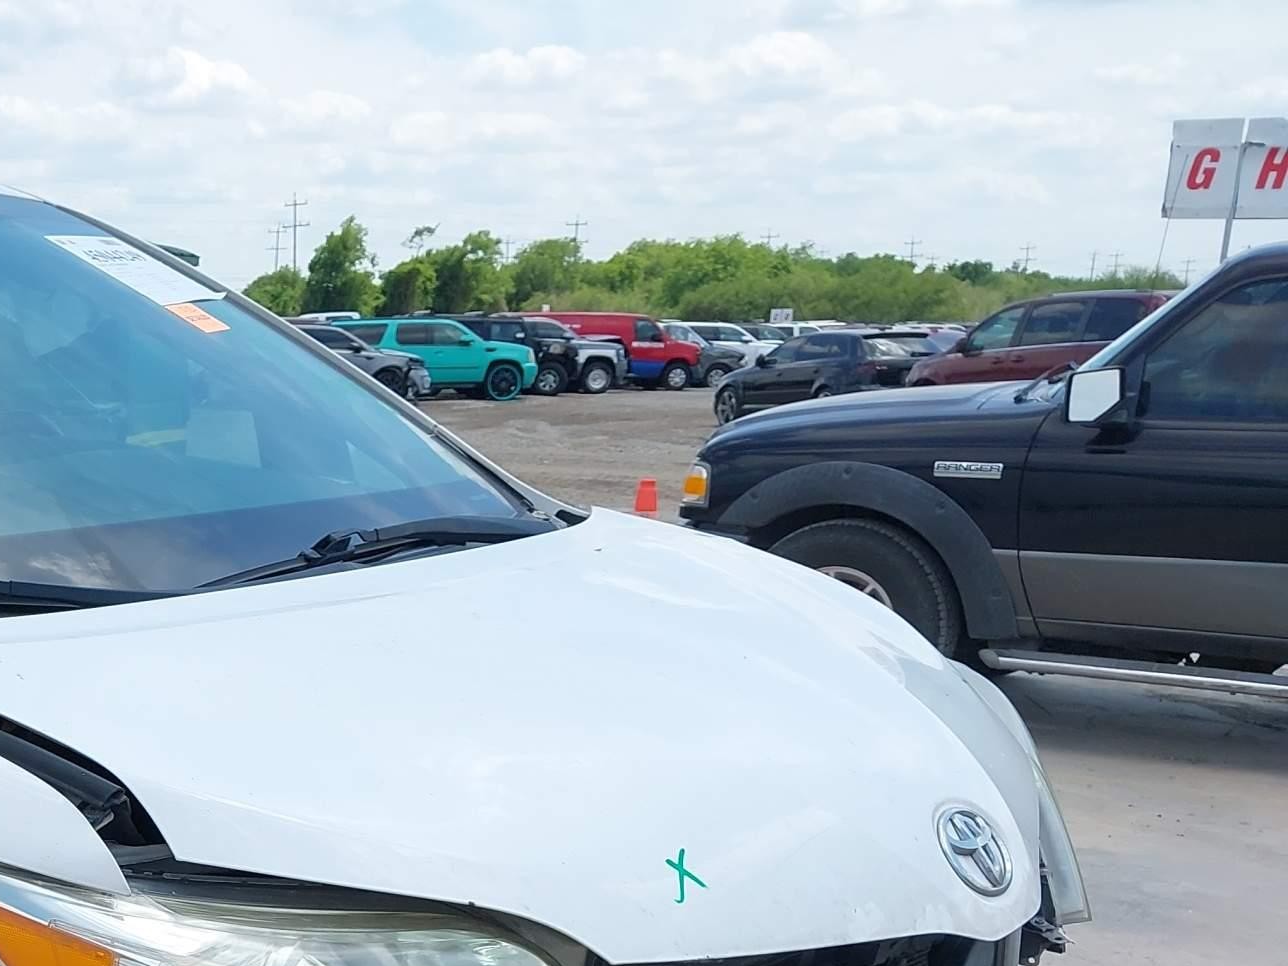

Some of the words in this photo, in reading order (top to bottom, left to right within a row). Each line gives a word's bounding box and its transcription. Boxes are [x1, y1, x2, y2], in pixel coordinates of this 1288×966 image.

[1187, 147, 1220, 190] G
[1255, 146, 1288, 190] H
[935, 463, 1001, 473] RANGER
